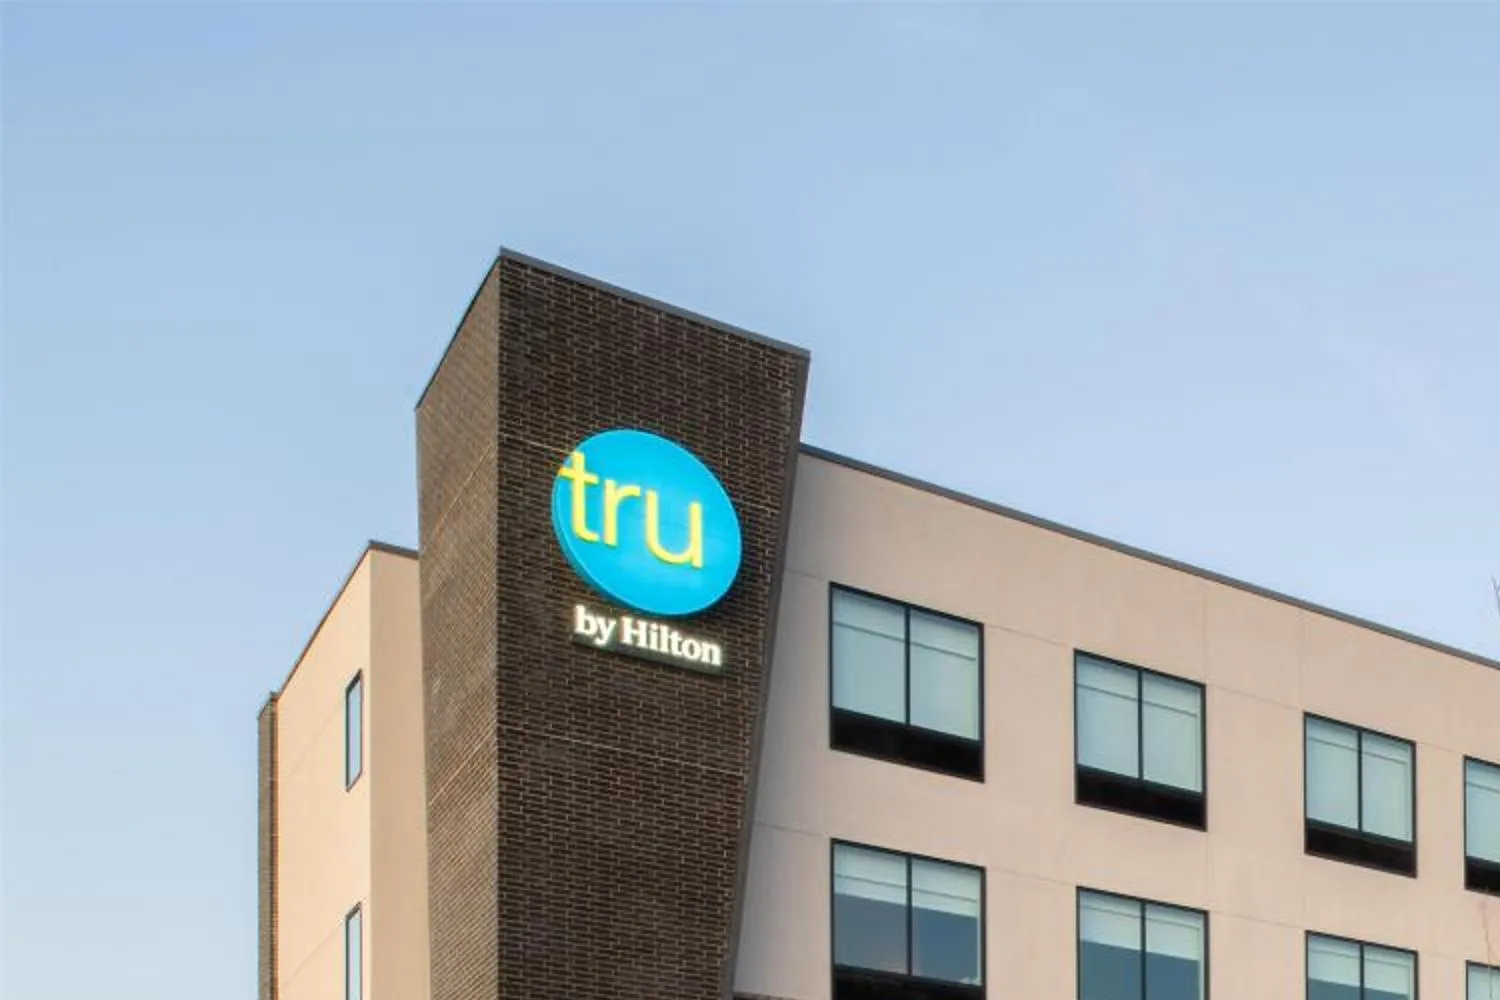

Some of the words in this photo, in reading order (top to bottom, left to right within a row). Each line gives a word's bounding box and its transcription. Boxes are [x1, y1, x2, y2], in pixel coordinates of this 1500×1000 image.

[557, 450, 704, 569] tru
[574, 604, 617, 645] by
[621, 615, 723, 666] Hilton
